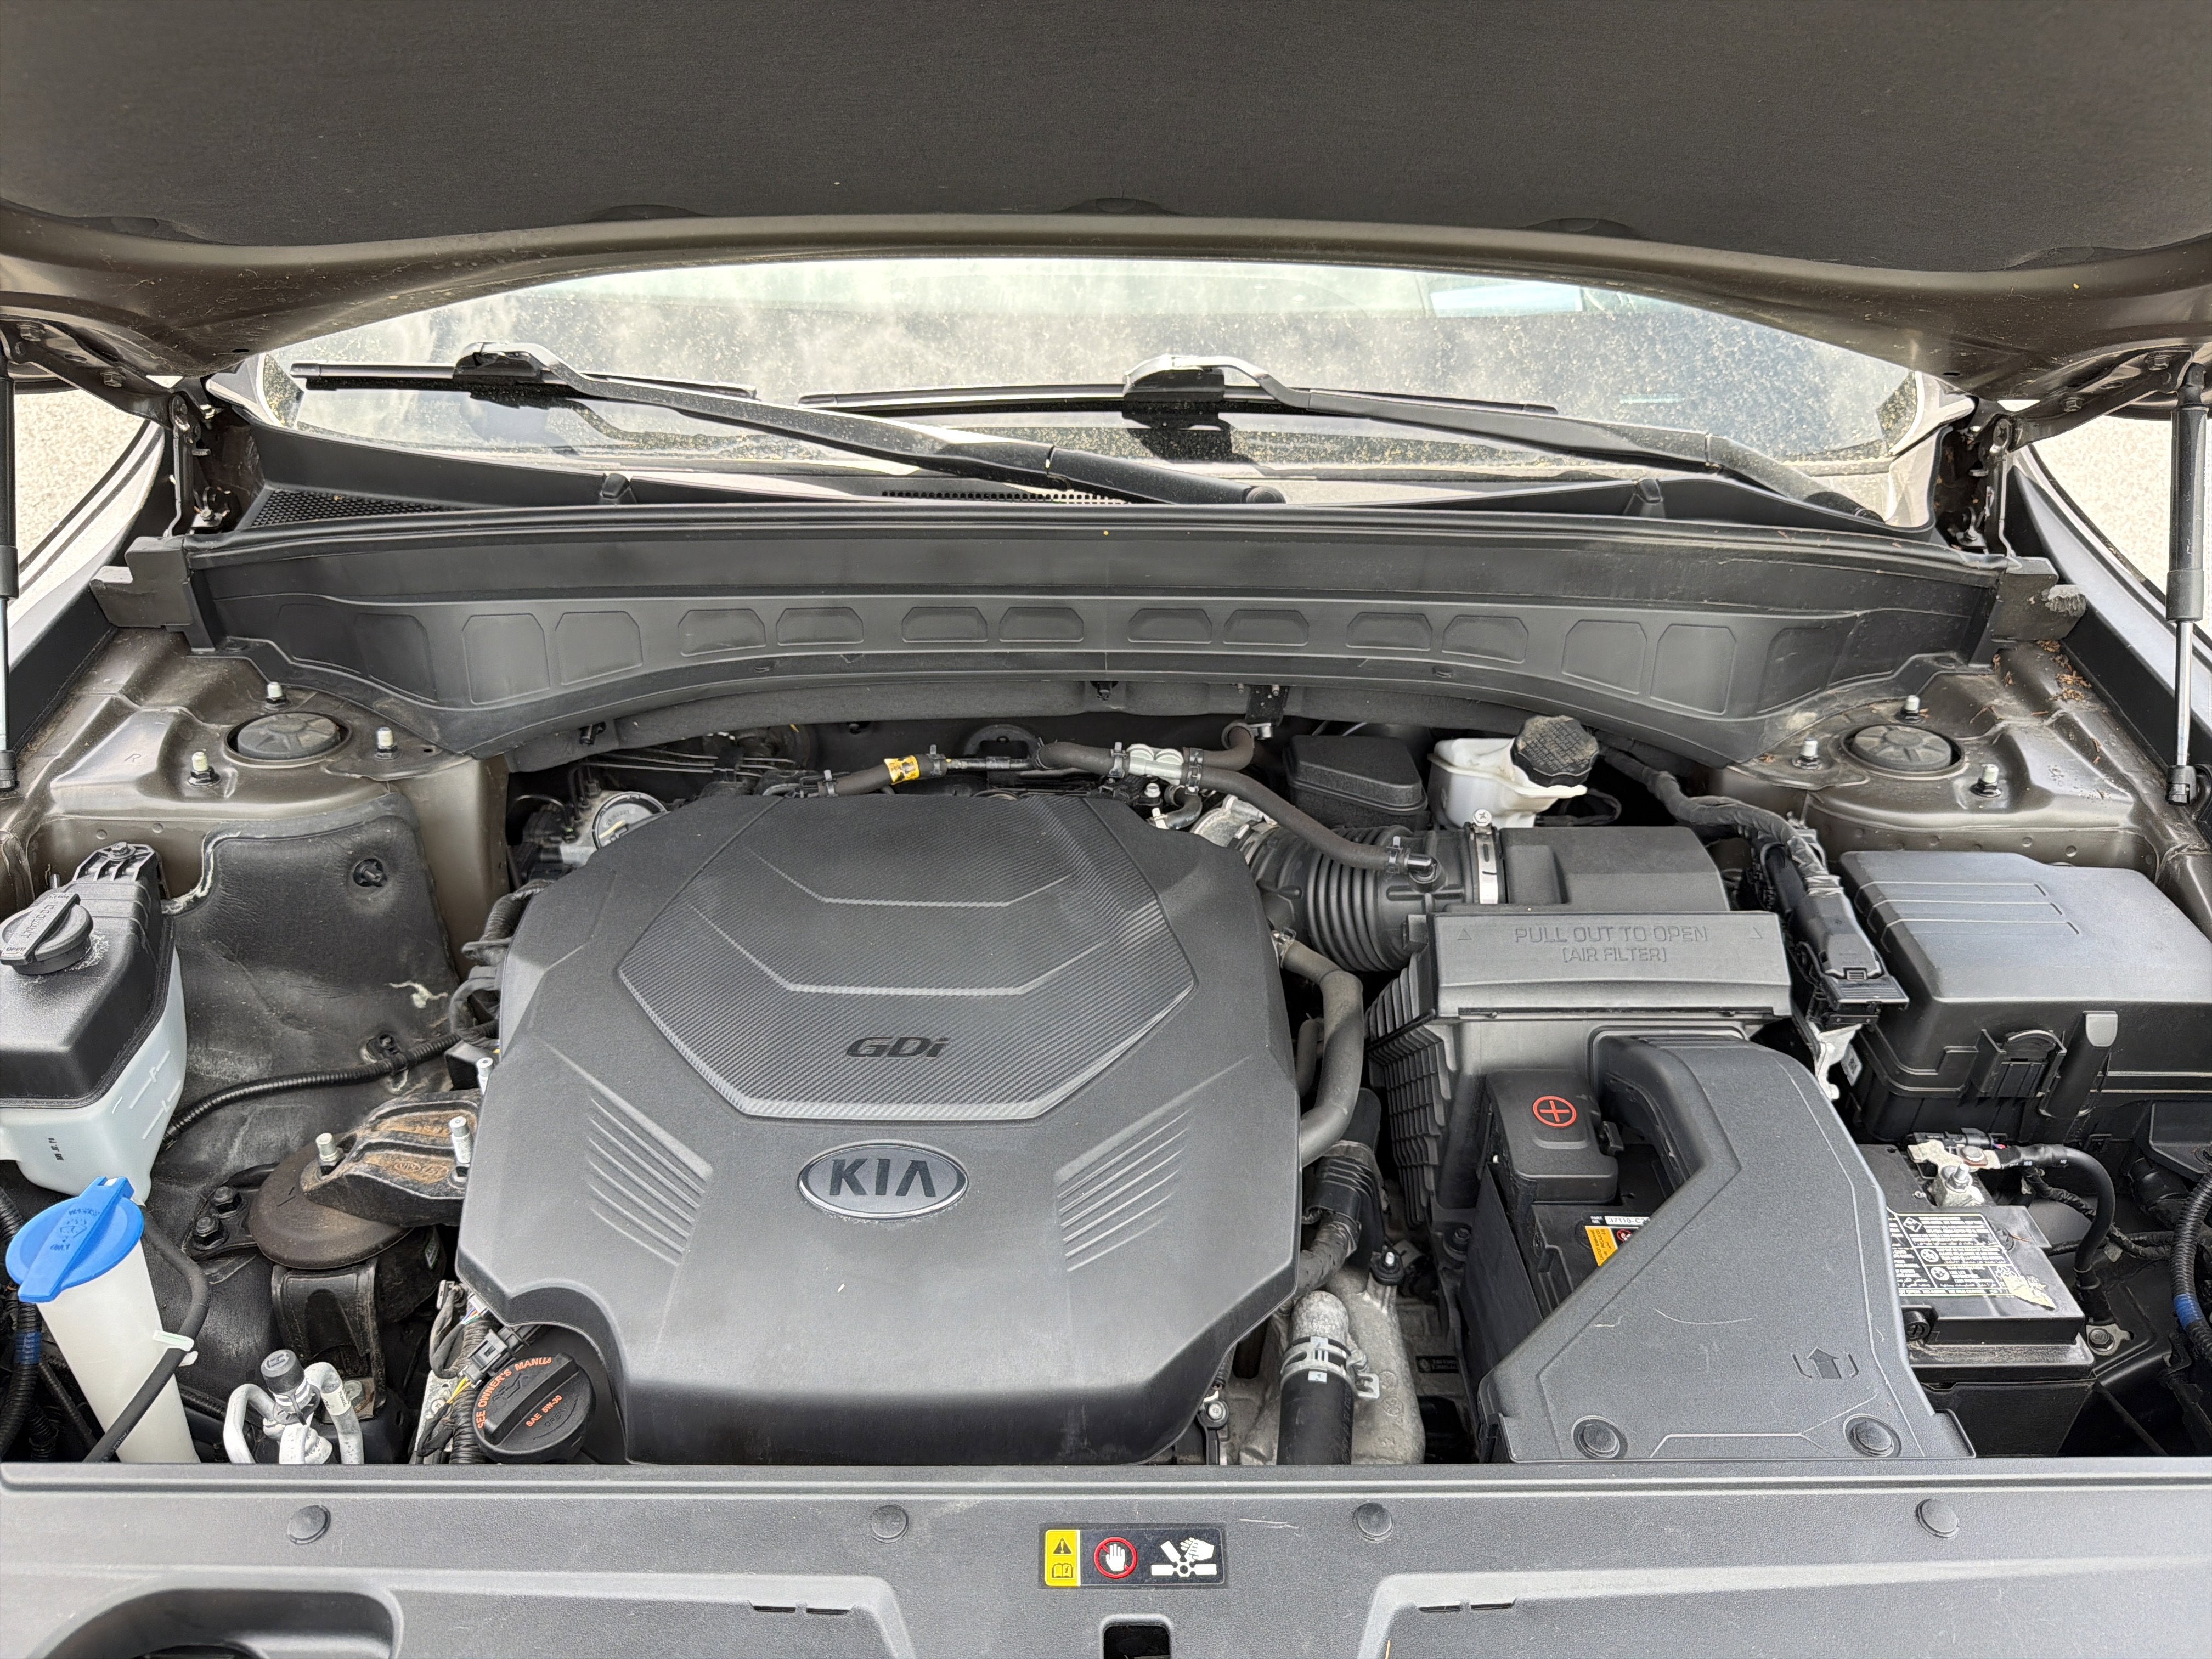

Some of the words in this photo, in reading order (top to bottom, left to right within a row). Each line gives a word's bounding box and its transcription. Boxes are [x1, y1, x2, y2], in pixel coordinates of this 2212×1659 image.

[21, 905, 55, 939] COOLANT
[1515, 927, 1567, 943] PULL
[1573, 927, 1612, 943] OUT
[1619, 927, 1647, 942] TO
[1654, 926, 1708, 943] OPEN
[846, 1037, 948, 1058] GDi
[830, 1157, 937, 1198] KIA
[514, 1356, 553, 1372] MANUA
[478, 1369, 513, 1408] OWNER'S
[476, 1410, 486, 1429] SEE
[526, 1412, 543, 1427] SAE
[541, 1395, 563, 1414] 5W-30
